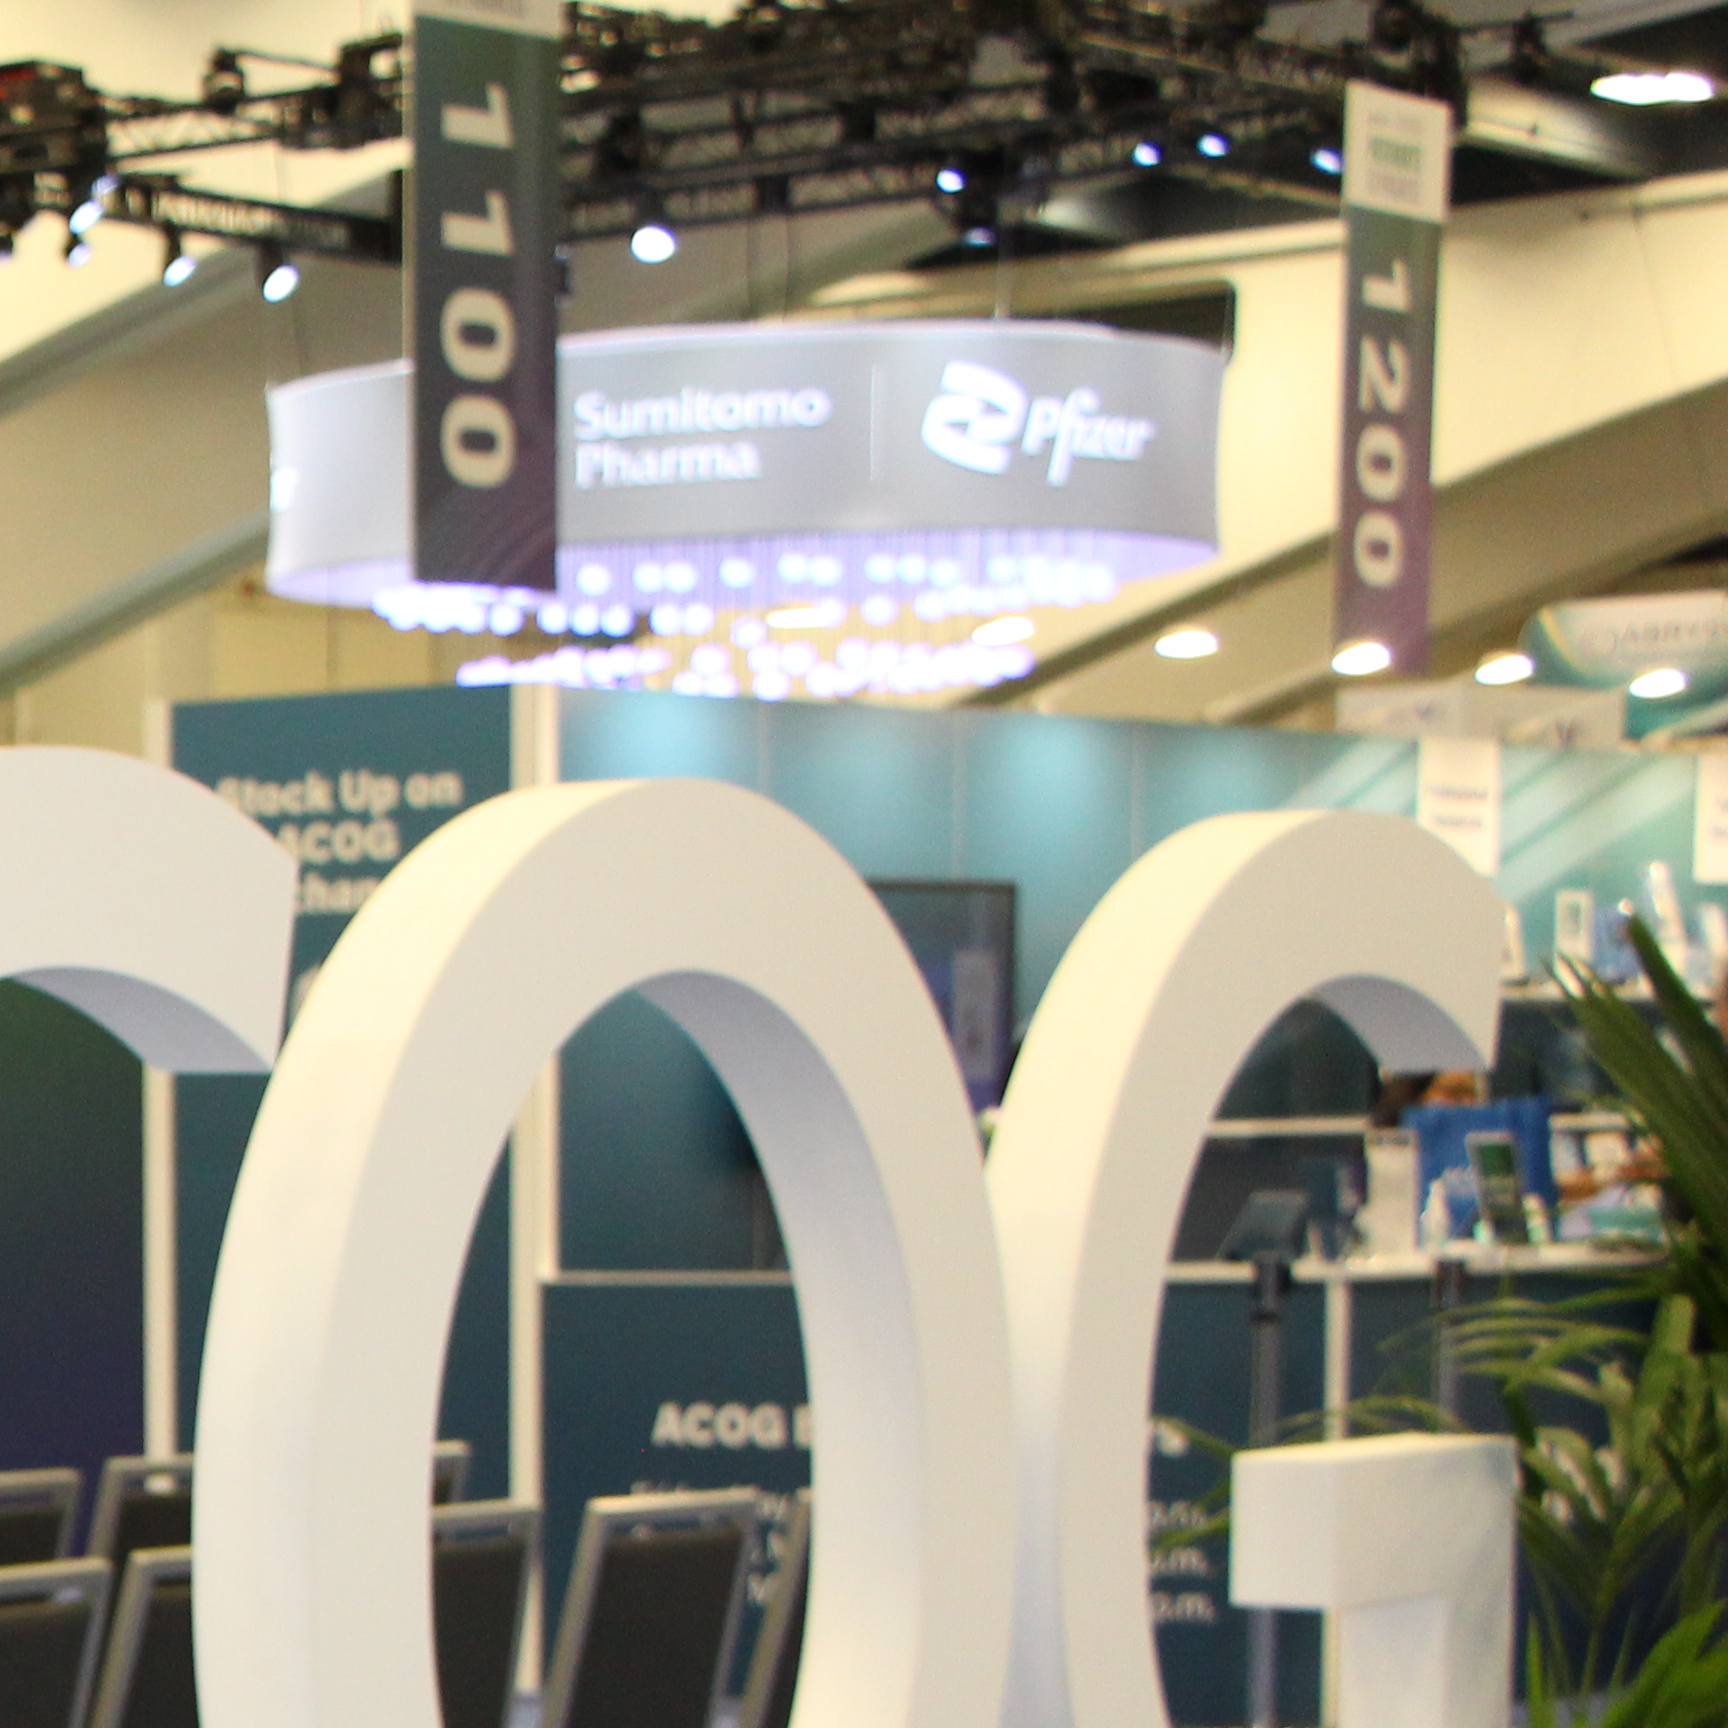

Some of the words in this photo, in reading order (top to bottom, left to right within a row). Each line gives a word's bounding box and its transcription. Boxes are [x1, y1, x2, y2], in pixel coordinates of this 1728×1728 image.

[440, 82, 516, 489] 1100
[573, 386, 831, 441] Sumitomo
[1021, 387, 1156, 487] Pfizer
[1354, 258, 1413, 588] 1200
[574, 440, 762, 489] Pharma
[338, 769, 401, 820] Up
[404, 772, 463, 810] on
[650, 1401, 787, 1450] ACOG
